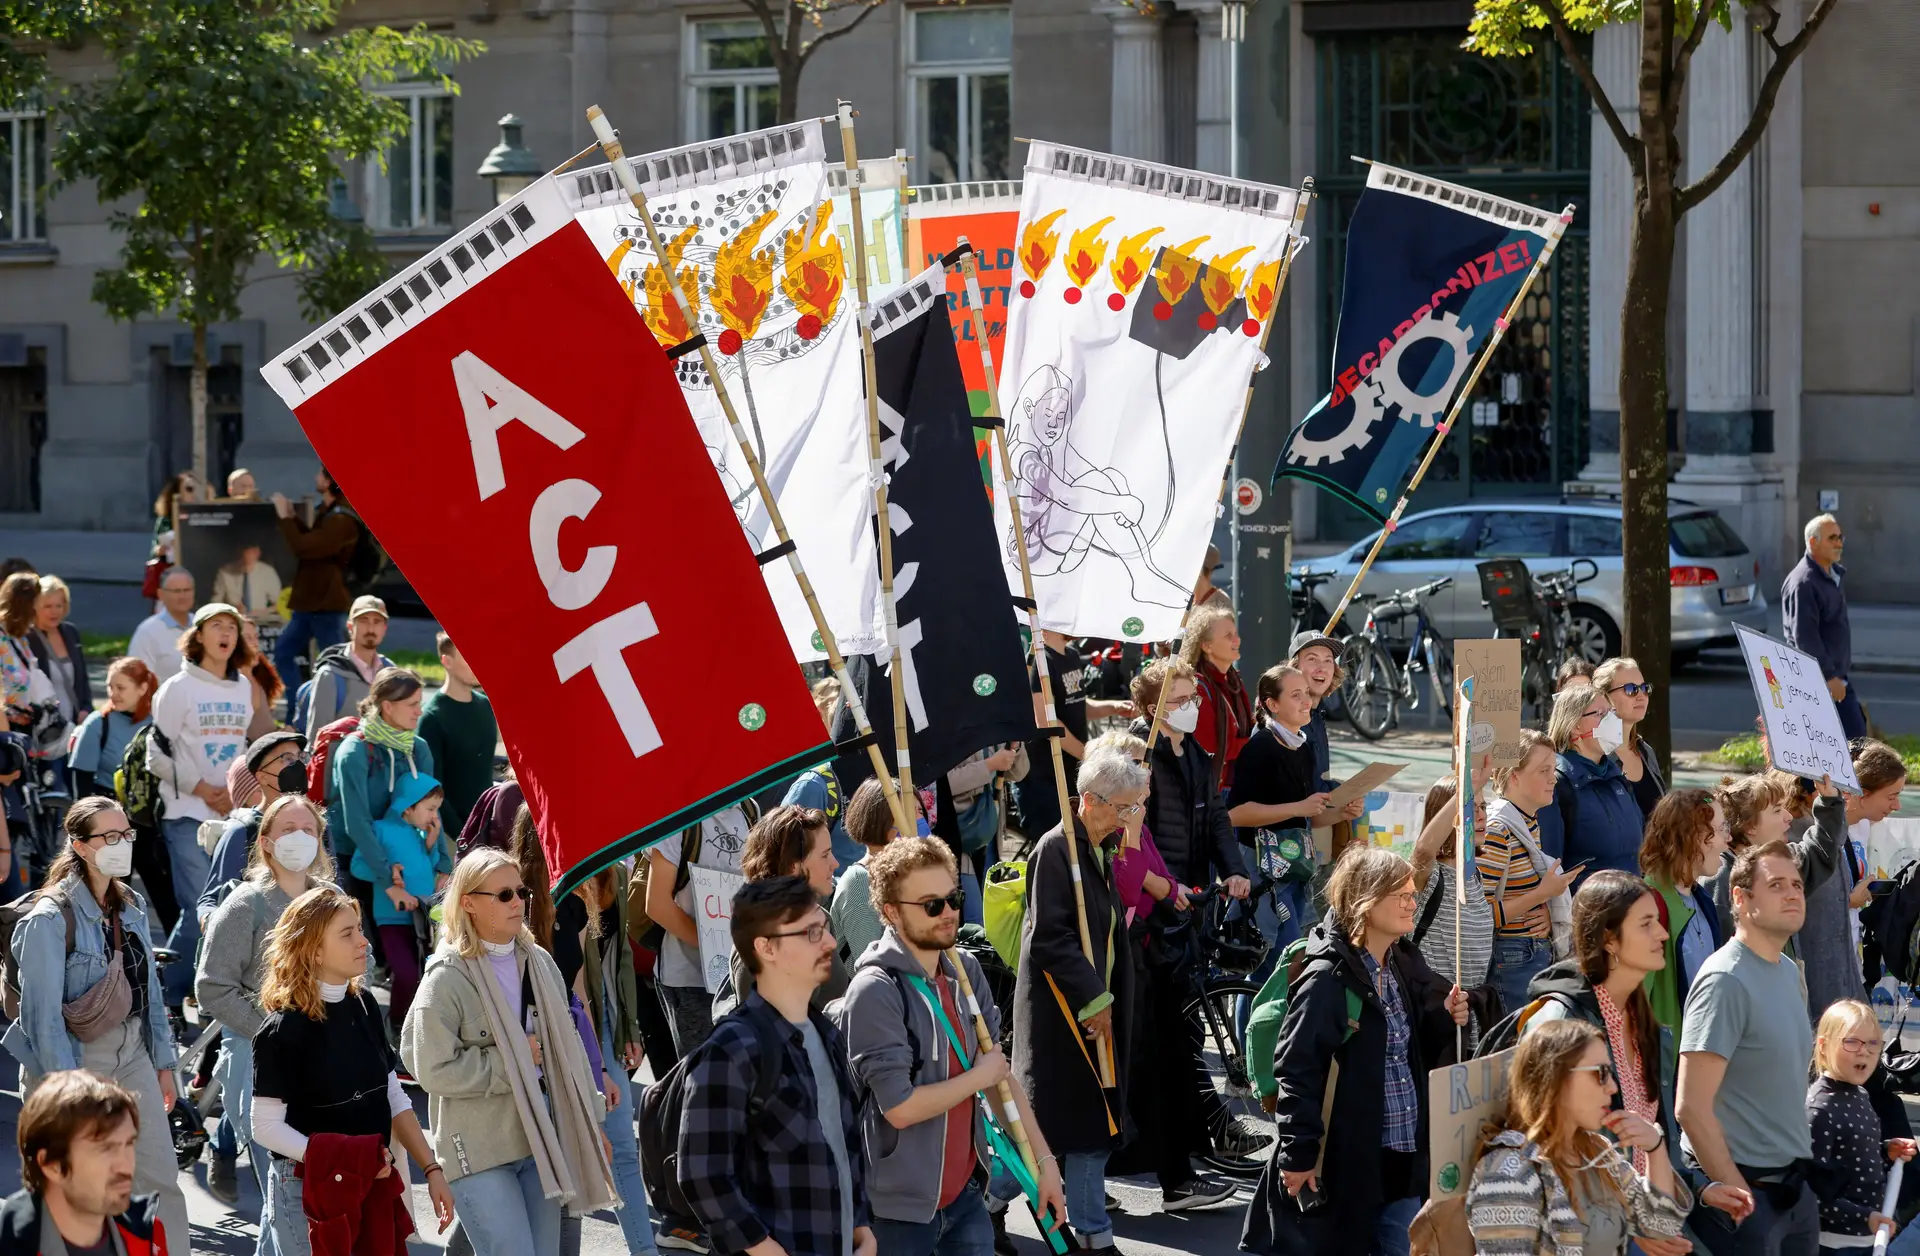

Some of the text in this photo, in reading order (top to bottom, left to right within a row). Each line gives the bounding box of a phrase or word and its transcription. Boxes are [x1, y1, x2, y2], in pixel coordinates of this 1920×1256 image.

[451, 350, 664, 759] ACT
[1465, 648, 1506, 695] System
[1480, 690, 1520, 713] CHANGE
[1802, 713, 1840, 749] Bienen
[700, 924, 728, 950] MIT
